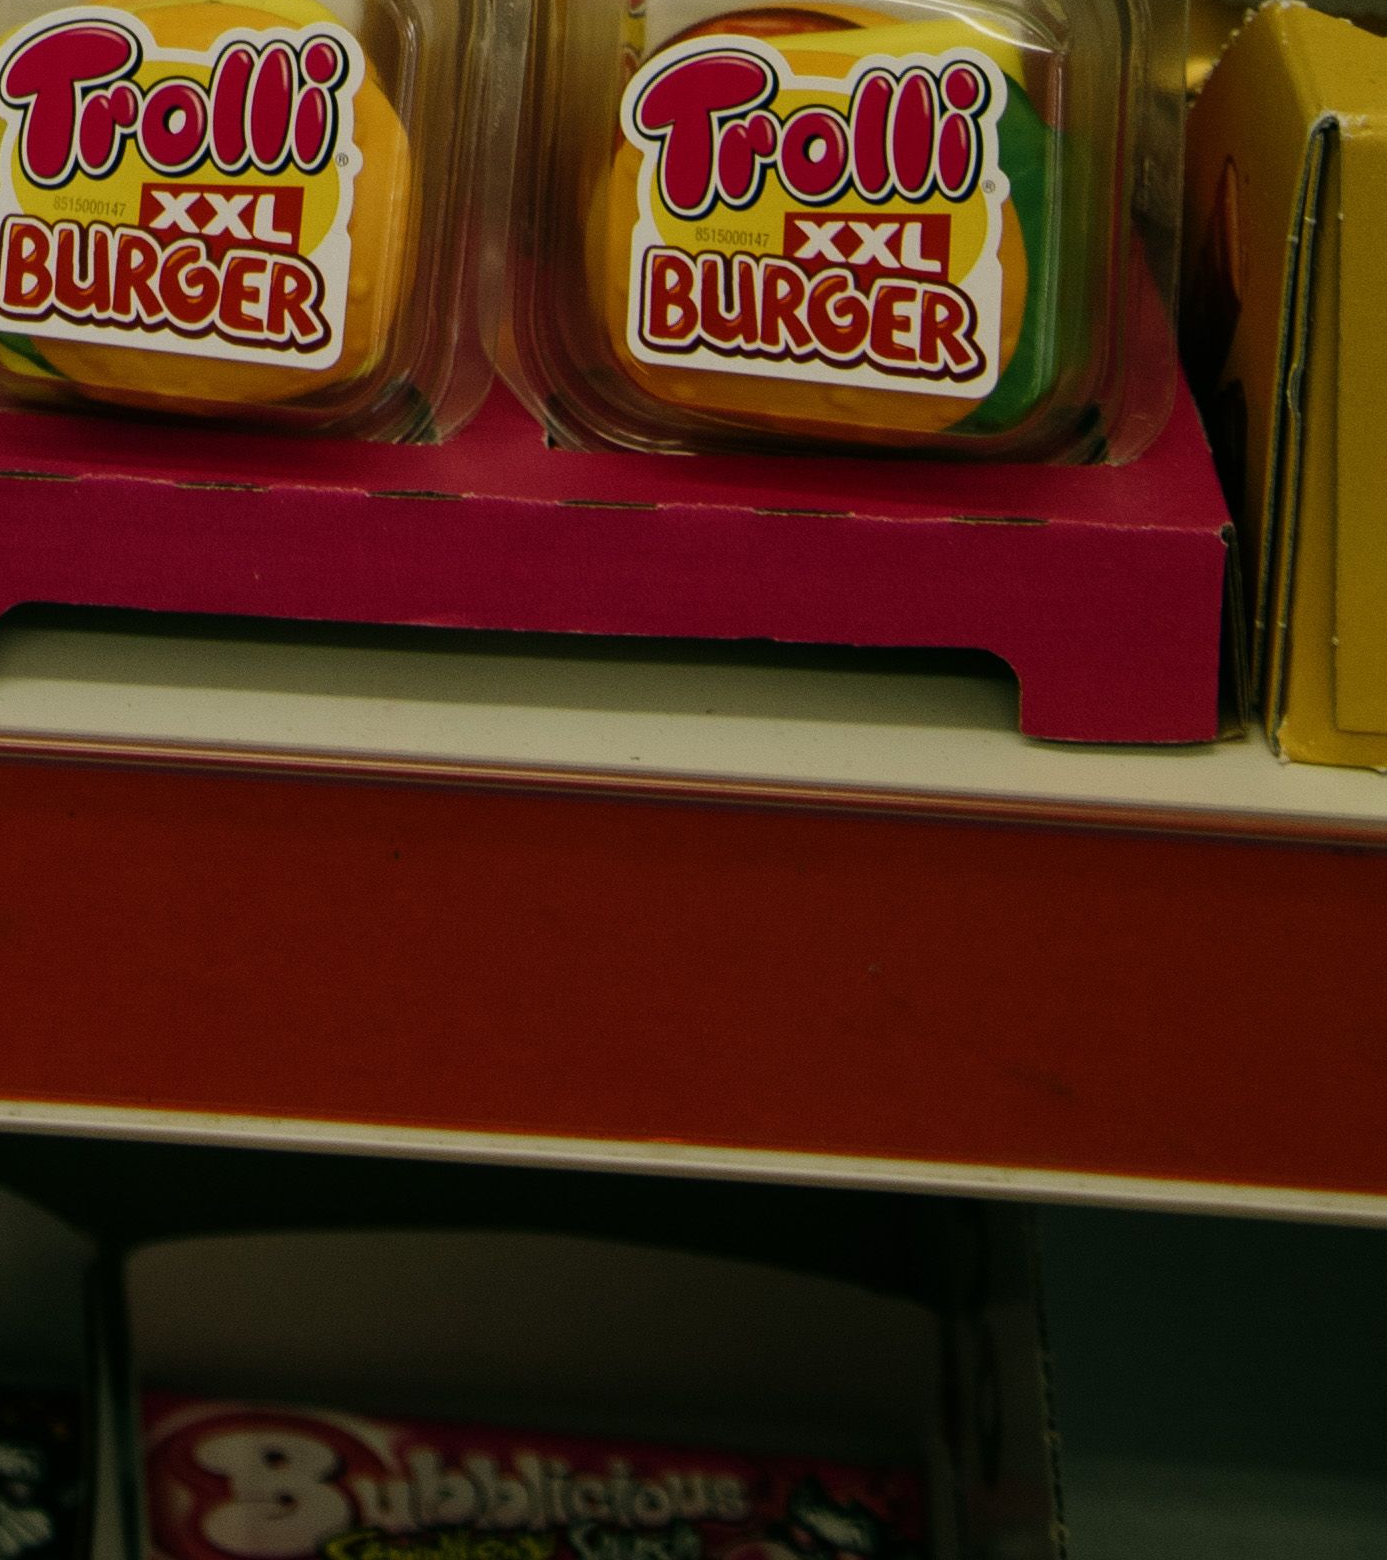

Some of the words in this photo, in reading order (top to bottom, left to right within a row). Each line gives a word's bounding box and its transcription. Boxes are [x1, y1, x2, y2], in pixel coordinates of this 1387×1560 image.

[634, 47, 991, 221] Trolli
[52, 194, 127, 218] 8515000147
[148, 190, 293, 245] XXL
[694, 226, 770, 249] 8515000147
[792, 219, 943, 273] XXL
[639, 246, 987, 384] BURGER
[194, 1425, 751, 1558] Bubblicious
